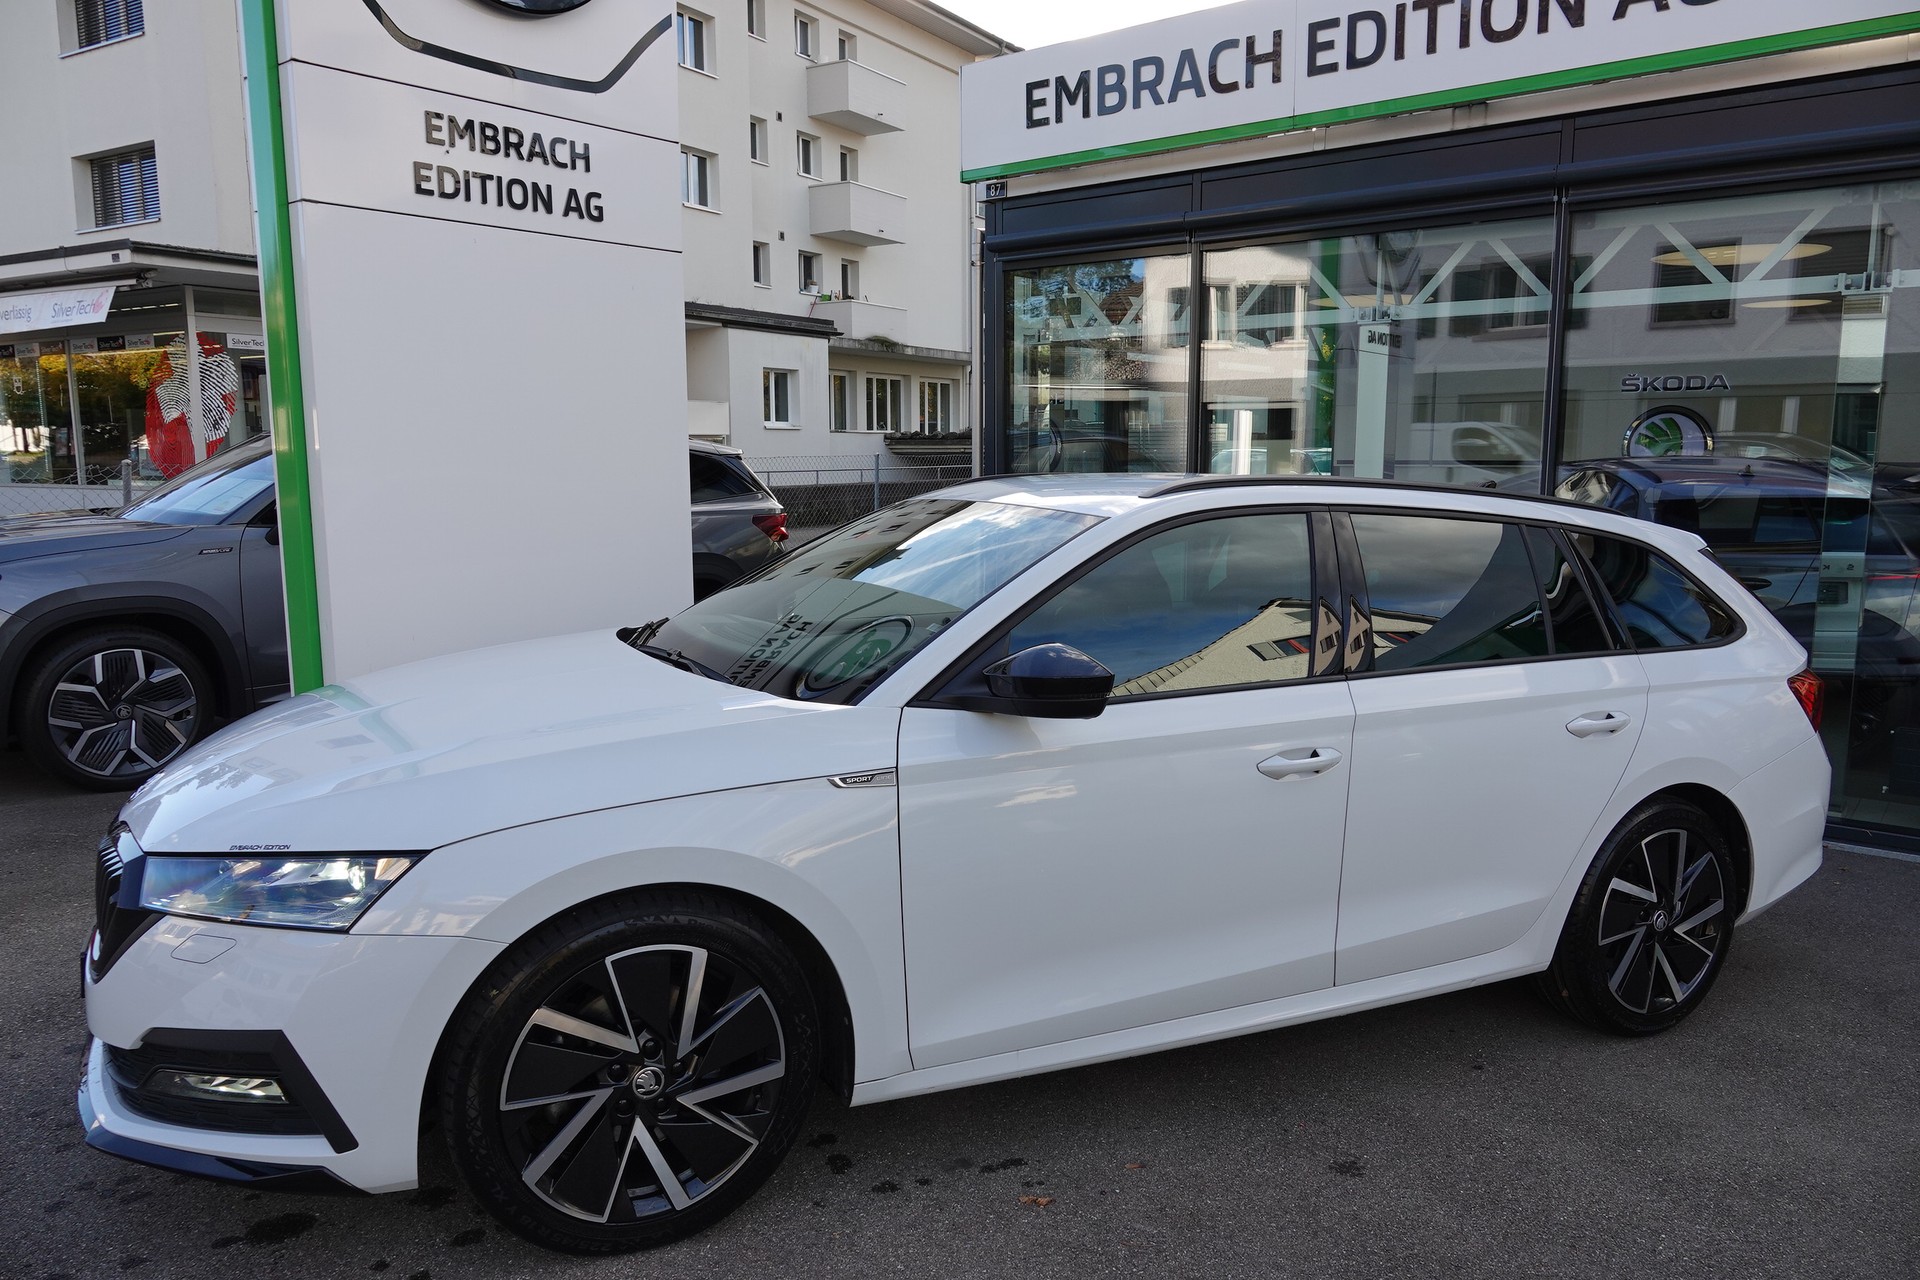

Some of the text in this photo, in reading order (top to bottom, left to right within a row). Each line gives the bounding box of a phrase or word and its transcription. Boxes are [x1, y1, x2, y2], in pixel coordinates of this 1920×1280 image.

[1025, 29, 1283, 130] EMBRACH
[424, 110, 591, 173] EMBRACH
[413, 160, 604, 223] EDITION AG
[990, 184, 1001, 197] 87
[1621, 373, 1731, 393] ŠKODA
[846, 775, 873, 784] SPORT
